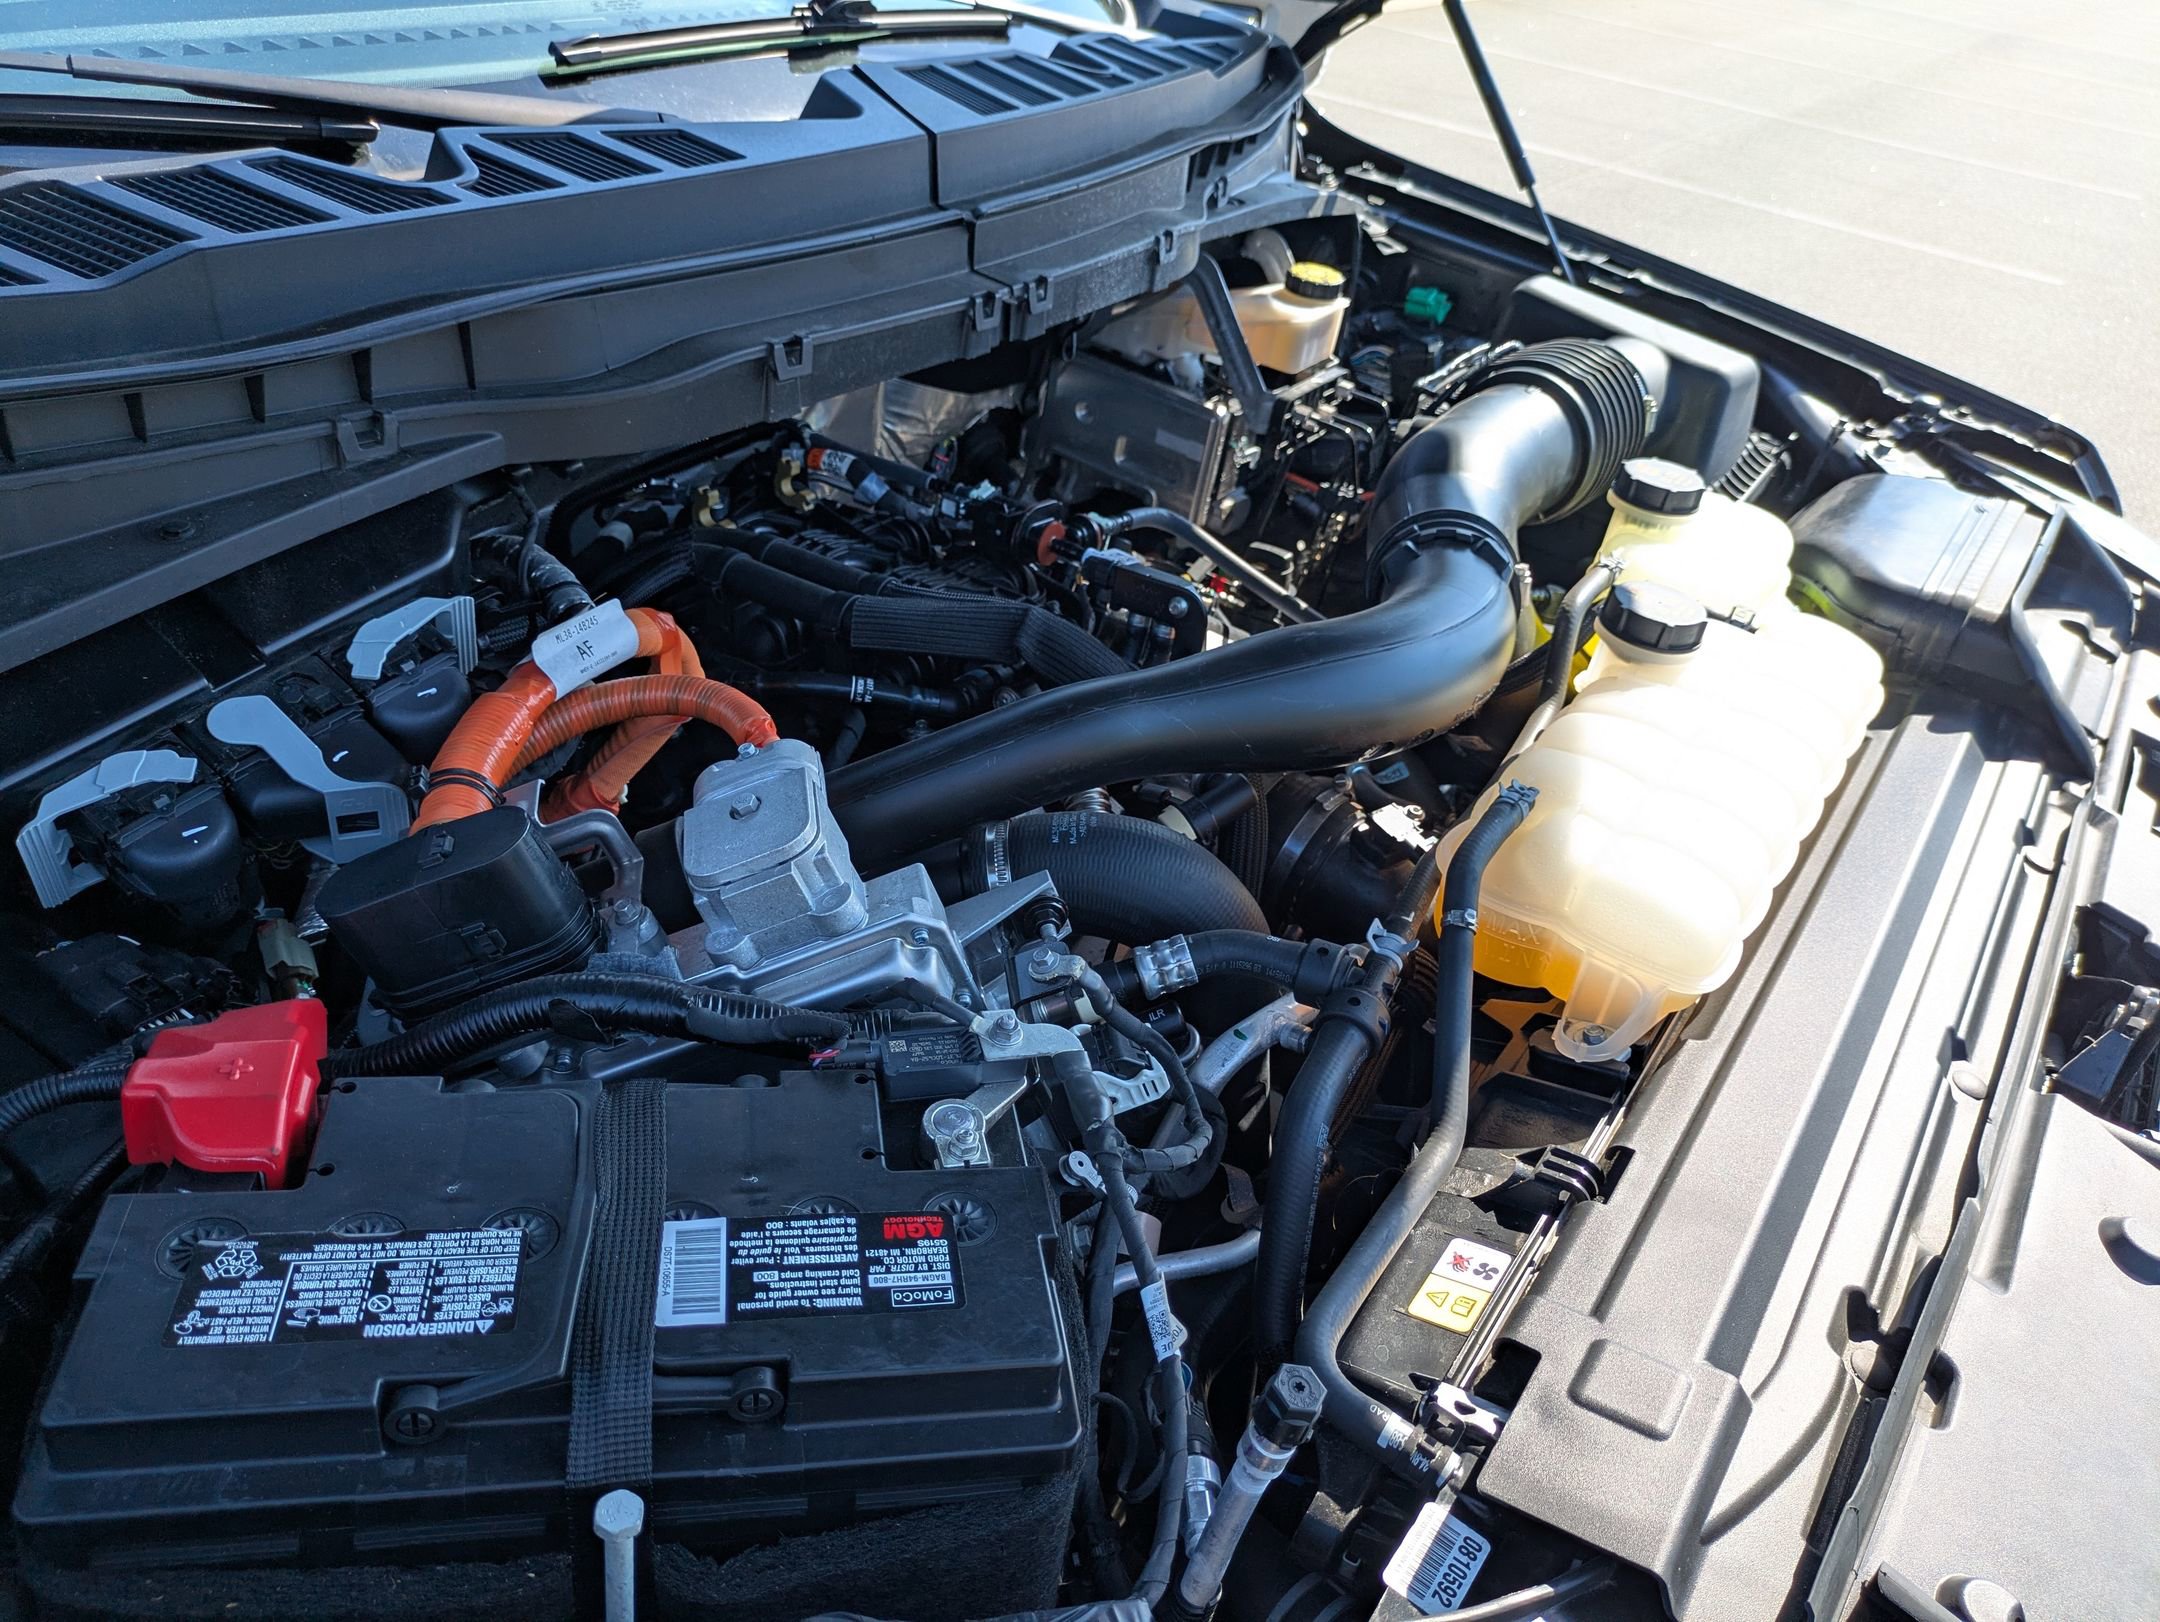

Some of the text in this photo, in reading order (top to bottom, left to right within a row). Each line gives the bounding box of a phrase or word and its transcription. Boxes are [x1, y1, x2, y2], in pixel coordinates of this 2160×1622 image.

[576, 640, 594, 661] AF
[1486, 912, 1542, 945] MAX
[1148, 1007, 1166, 1021] ILR
[766, 1221, 783, 1229] 800
[790, 1219, 818, 1228] volants
[472, 1231, 497, 1239] OUVRIR
[772, 1229, 802, 1237] secours
[883, 1222, 944, 1240] AGM
[358, 1242, 371, 1250] PAS
[418, 1240, 432, 1248] DES
[481, 1238, 500, 1246] HORS
[730, 1239, 763, 1247] methode
[765, 1238, 772, 1246] la
[444, 1247, 466, 1255] REACH
[504, 1245, 520, 1253] KEEP
[750, 1248, 772, 1256] guide
[844, 1244, 858, 1252] des
[314, 1251, 331, 1259] OPEN
[387, 1249, 397, 1257] DO
[731, 1257, 754, 1265] eviter
[782, 1253, 858, 1264] AVERTISSEMENT
[896, 1255, 926, 1263] MOTOR
[928, 1254, 949, 1262] FORD
[443, 1267, 469, 1275] PEUVENT
[470, 1266, 503, 1274] EXPLOSIFS
[805, 1270, 839, 1278] cranking
[842, 1269, 860, 1277] Cold
[468, 1275, 480, 1283] LES
[780, 1271, 803, 1279] amps
[874, 1274, 946, 1284] BAGM-94RH7-800
[435, 1277, 447, 1285] LES
[448, 1276, 466, 1284] YEUX
[819, 1278, 838, 1286] start
[840, 1277, 860, 1286] jump
[293, 1280, 337, 1289] SULFURIQUE
[242, 1288, 280, 1296] CONSULTEZ
[352, 1289, 363, 1297] OR
[443, 1284, 514, 1294] BLINDNESS OR INJURY
[754, 1286, 861, 1299] injury see owner guide for
[325, 1290, 351, 1298] SEVERE
[432, 1293, 491, 1303] GASES CAN CAUSE
[894, 1290, 952, 1302] FoMoCo
[286, 1299, 323, 1308] BLINDNESS
[324, 1298, 348, 1306] CAUSE
[393, 1296, 422, 1304] SMOKING
[738, 1297, 862, 1310] WARNING: To avoid personal
[218, 1306, 236, 1314] YEUX
[252, 1305, 275, 1313] RINCEZ
[340, 1306, 359, 1314] ACID
[442, 1302, 481, 1311] EXPLOSIVE
[318, 1314, 357, 1324] SULFURIC
[408, 1313, 418, 1321] NO
[434, 1310, 480, 1320] SHIELD EYES
[228, 1316, 272, 1325] MEDICAL HELP
[252, 1325, 269, 1333] WITH
[363, 1321, 474, 1337] DANGER/POISON
[178, 1334, 267, 1344] FLUSH EYES IMMEDIATELY
[1369, 1404, 1390, 1421] RAD
[1432, 1536, 1483, 1608] 0810592
